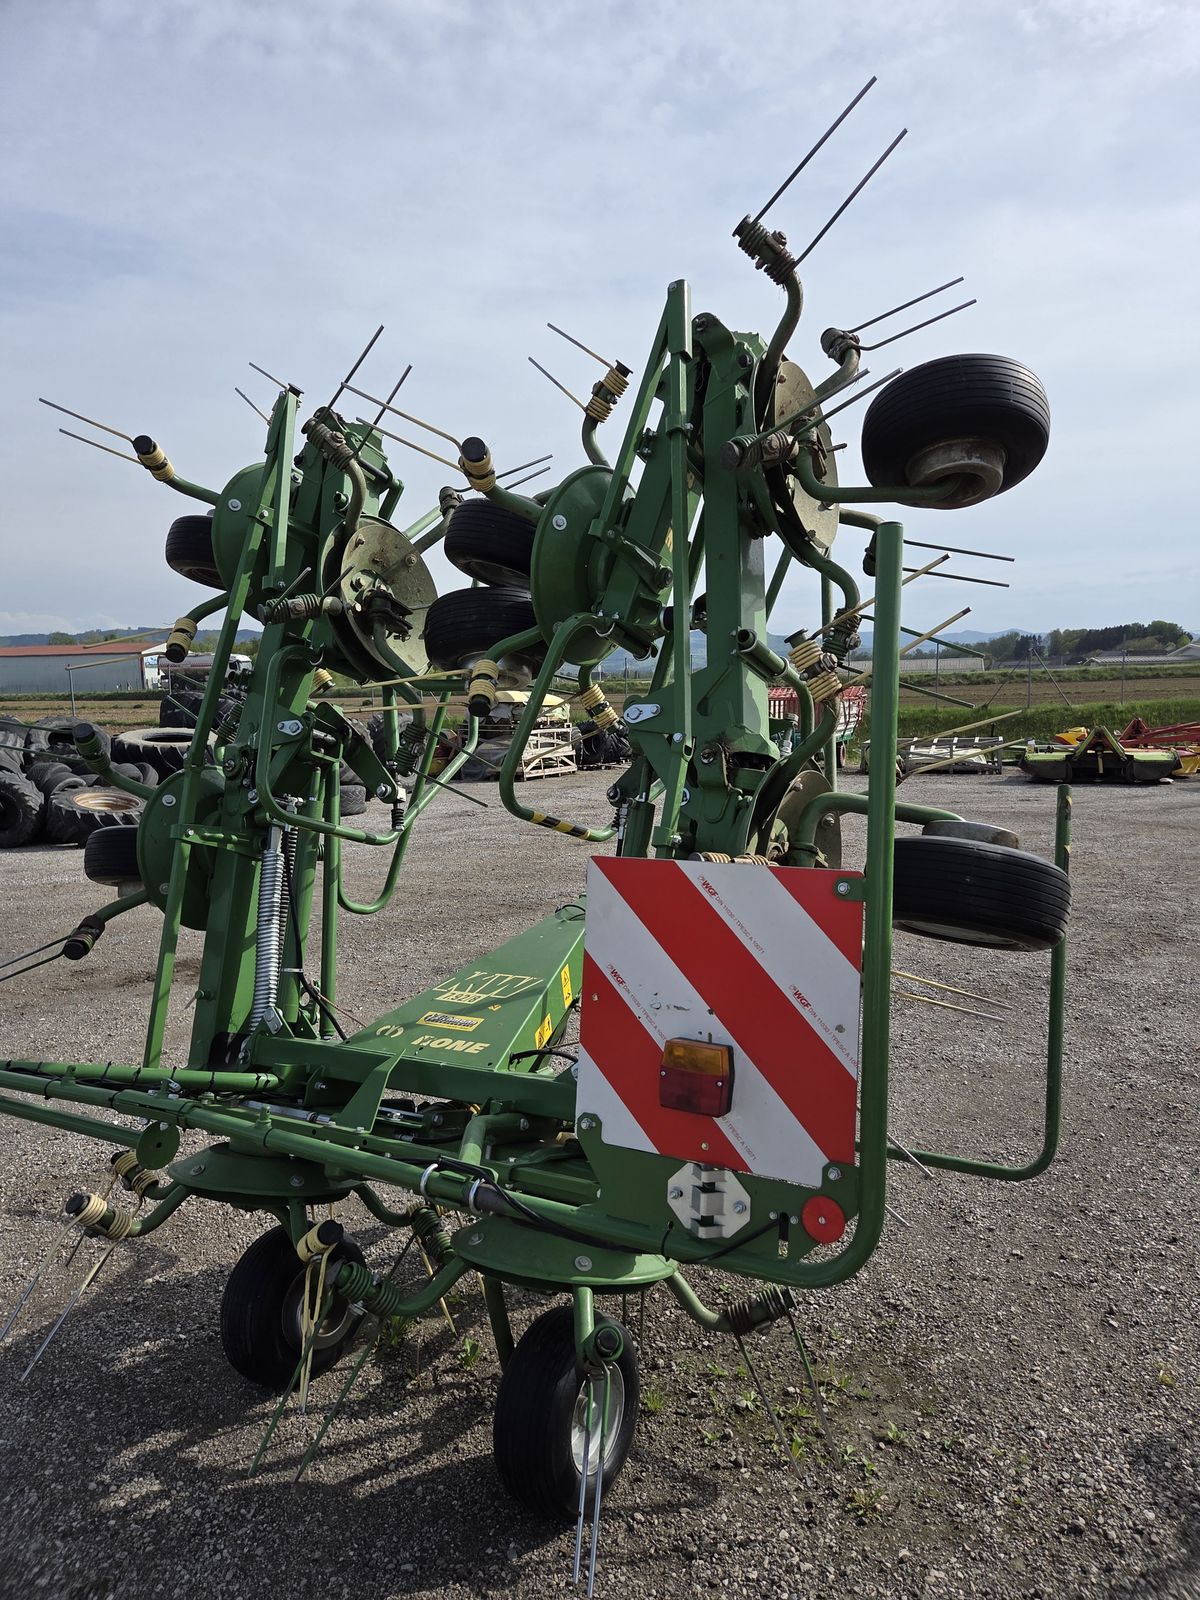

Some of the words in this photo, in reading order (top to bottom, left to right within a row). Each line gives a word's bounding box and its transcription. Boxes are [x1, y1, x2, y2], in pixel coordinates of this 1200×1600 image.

[701, 879, 718, 898] WGF
[609, 968, 626, 986] WGF
[792, 989, 811, 1009] WGF
